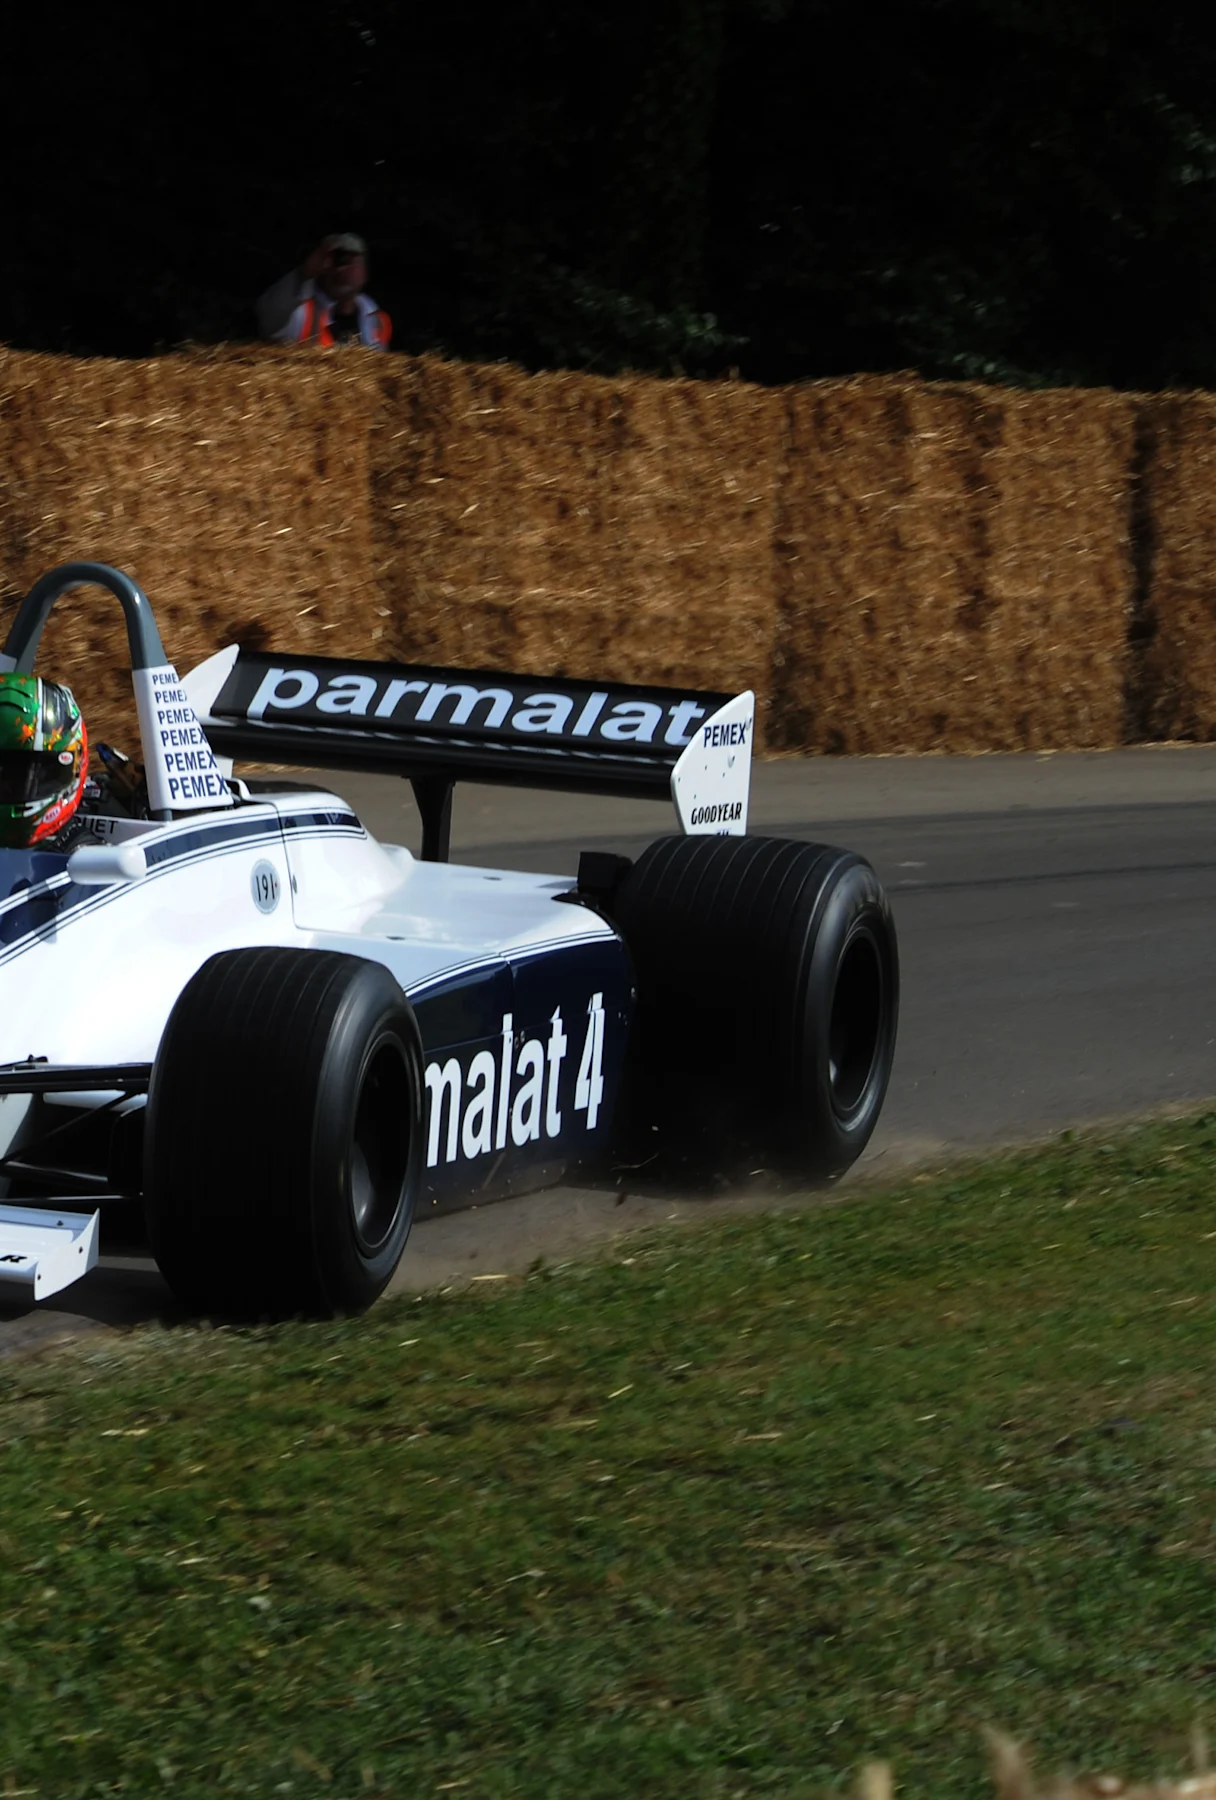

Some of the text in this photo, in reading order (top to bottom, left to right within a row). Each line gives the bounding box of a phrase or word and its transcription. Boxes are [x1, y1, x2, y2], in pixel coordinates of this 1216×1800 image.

[152, 672, 180, 685] PEME
[247, 667, 705, 746] parmalat
[160, 727, 208, 747] PEMEX
[703, 723, 746, 748] PEMEX
[164, 750, 218, 772] PEMEX
[168, 774, 229, 800] PEMEX
[691, 802, 742, 826] GOODYEAR
[255, 873, 275, 902] 191
[574, 991, 606, 1130] 4
